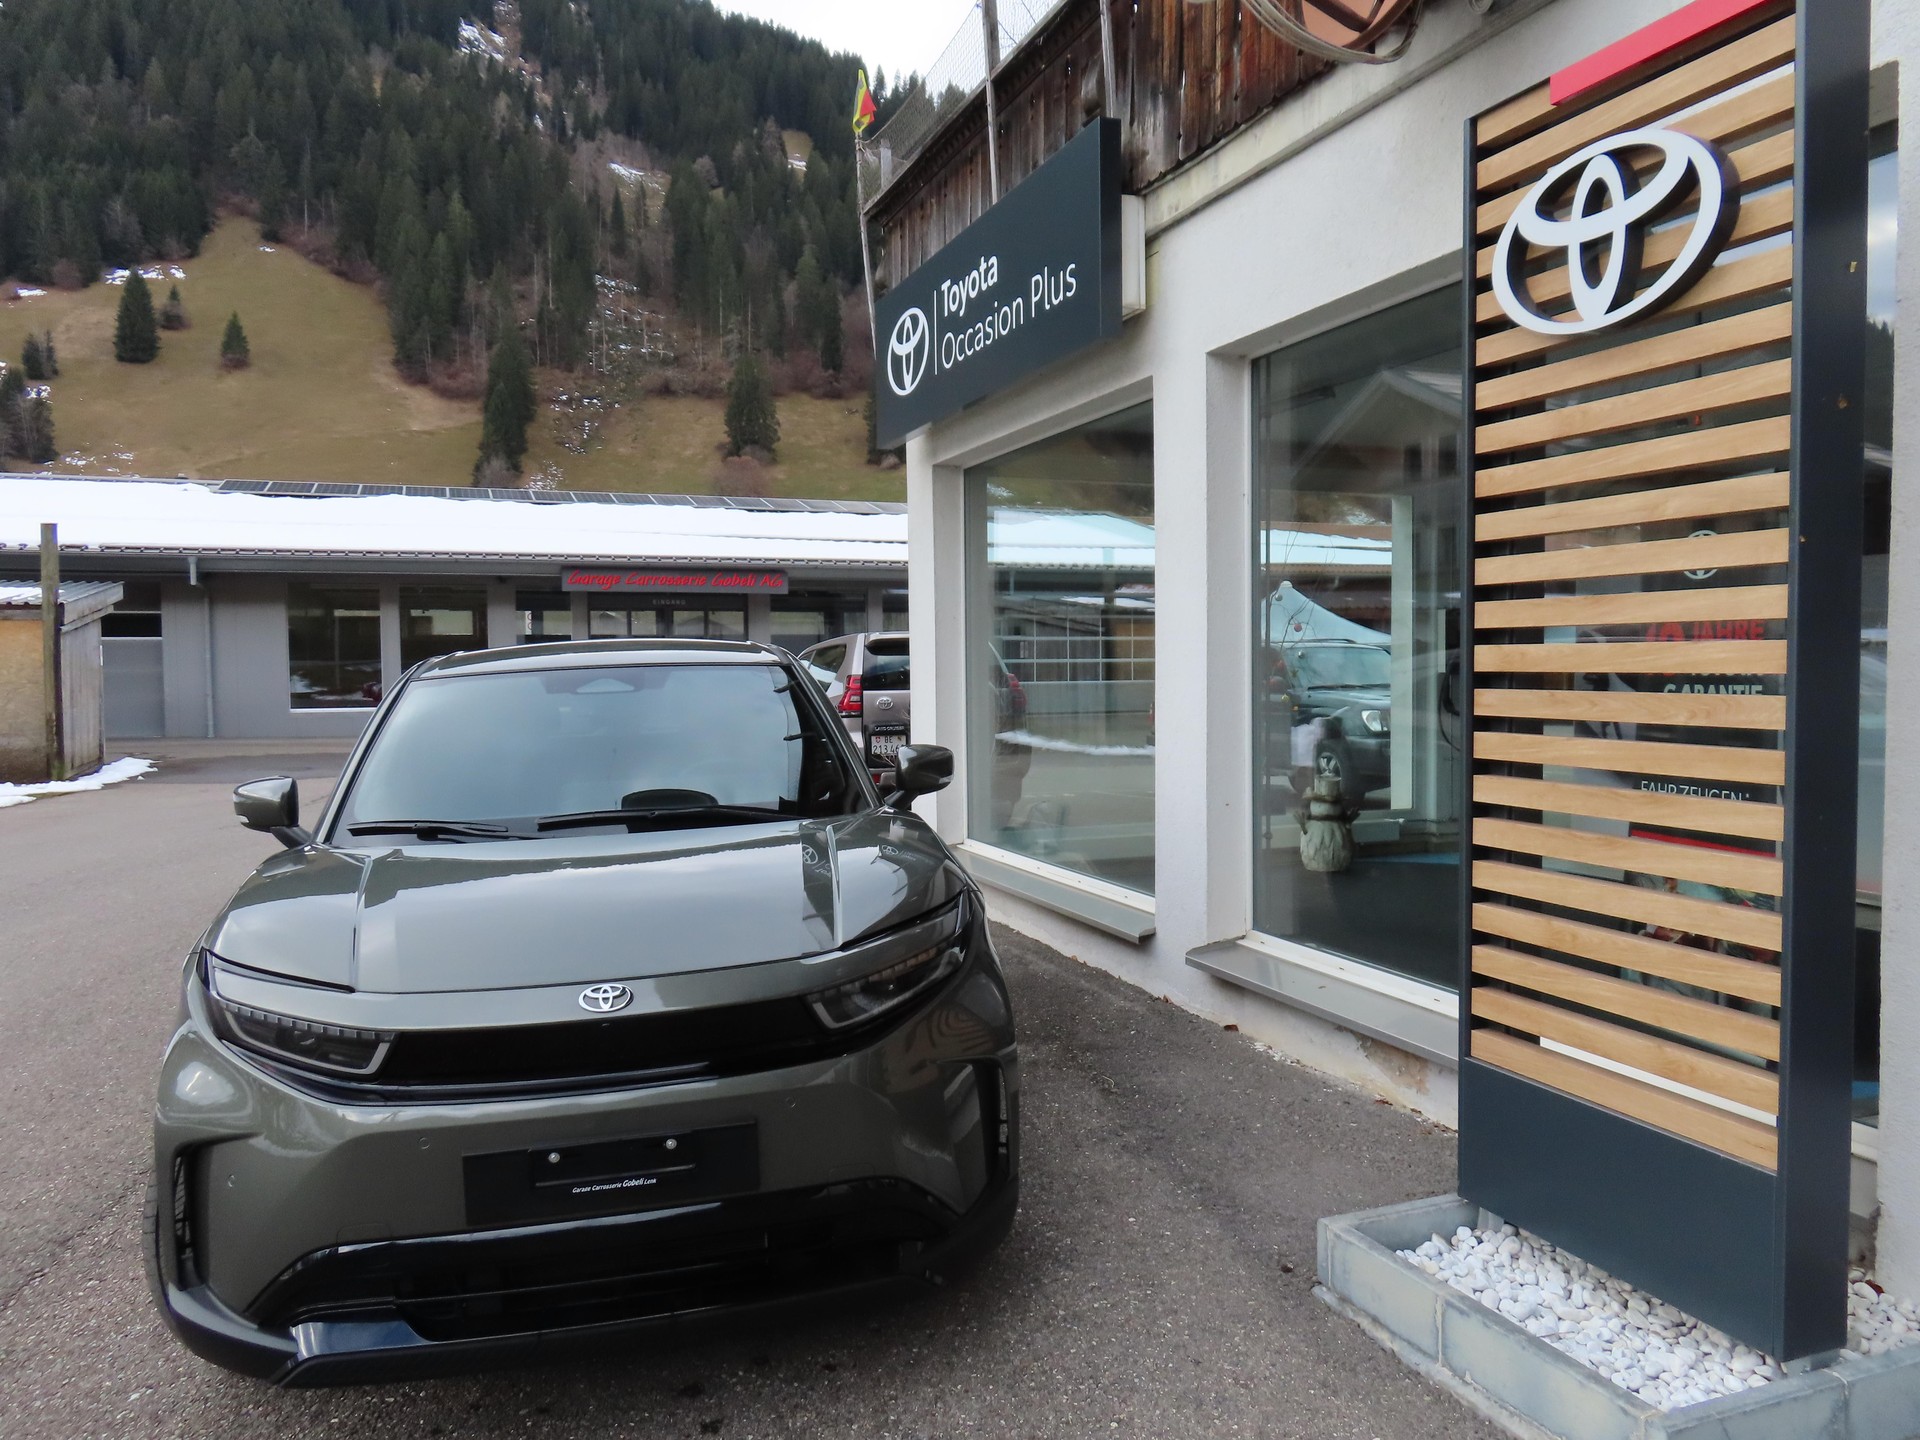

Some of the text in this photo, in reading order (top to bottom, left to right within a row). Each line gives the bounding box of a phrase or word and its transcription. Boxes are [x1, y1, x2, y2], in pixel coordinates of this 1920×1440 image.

[940, 255, 999, 317] Toyota
[941, 263, 1077, 369] Occasion Plus
[567, 569, 784, 590] Garage Carrosserie Gobeli AG
[884, 736, 894, 744] BE
[591, 1182, 622, 1191] Carrosserie
